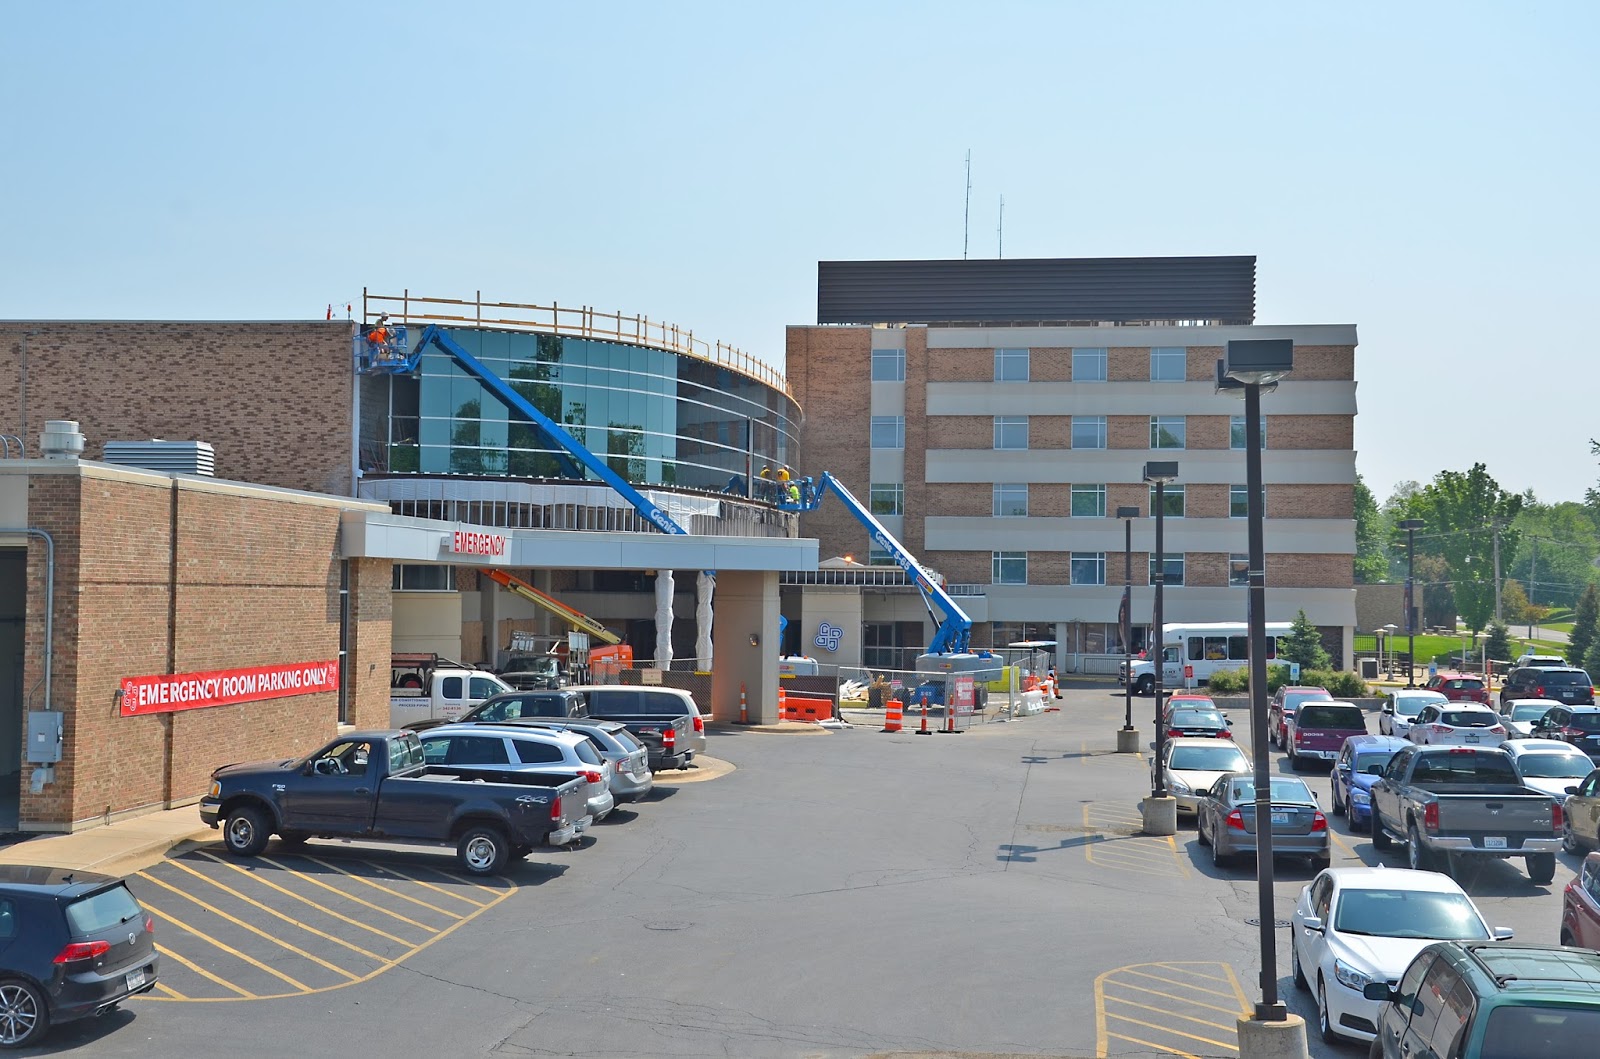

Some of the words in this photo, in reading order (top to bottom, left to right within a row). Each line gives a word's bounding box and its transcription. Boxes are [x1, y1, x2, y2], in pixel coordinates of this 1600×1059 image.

[650, 508, 677, 534] Genie
[454, 531, 506, 556] EMERGENCY
[875, 530, 893, 552] Genie
[893, 550, 911, 570] S-65
[139, 678, 222, 706] EMERGENCY
[222, 674, 257, 697] ROOM
[258, 669, 301, 692] PARKING
[303, 667, 328, 687] ONLY
